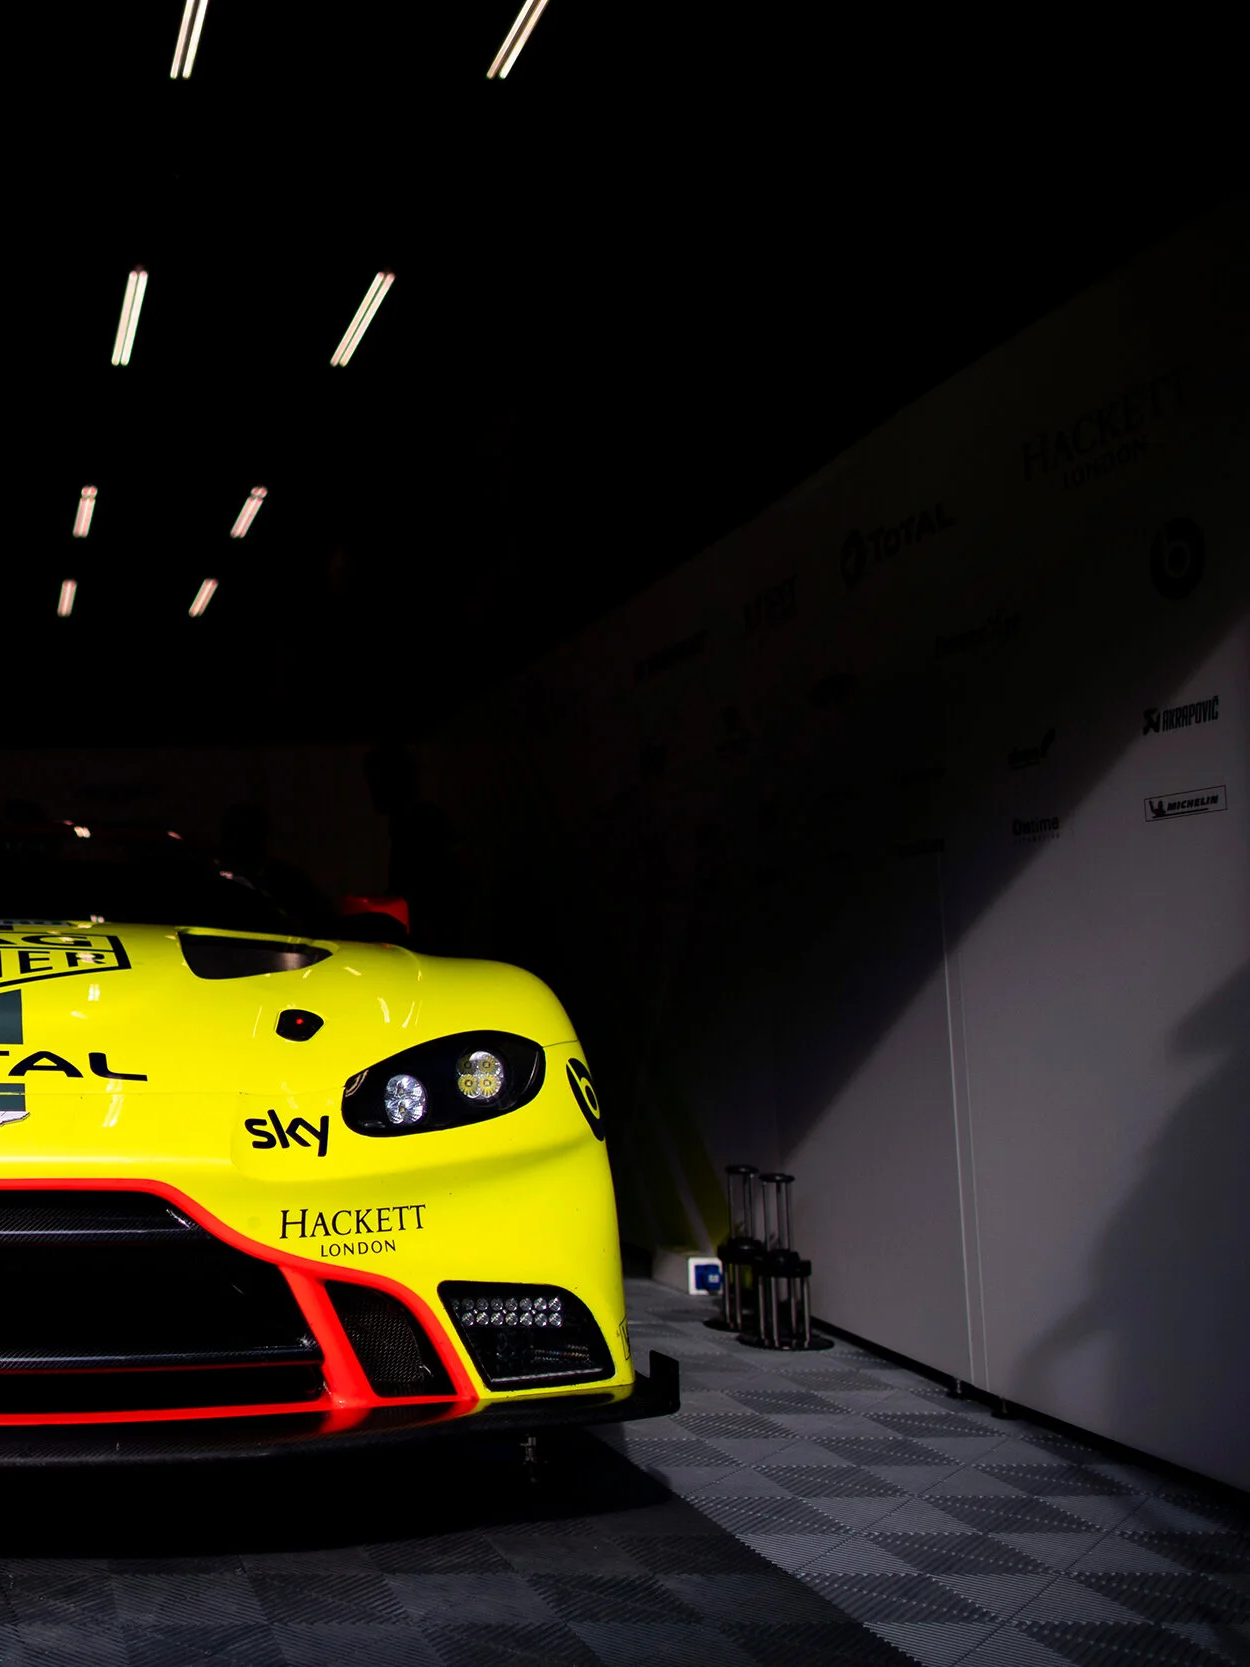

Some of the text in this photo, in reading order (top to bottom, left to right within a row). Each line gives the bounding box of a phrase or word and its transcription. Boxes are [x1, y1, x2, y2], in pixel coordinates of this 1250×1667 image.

[1022, 362, 1194, 482] HACKETT
[866, 503, 956, 563] TOTAL
[1166, 795, 1219, 811] MICHELIN
[244, 1108, 330, 1158] sky
[279, 1204, 427, 1240] HACKETT
[320, 1239, 397, 1258] LONDON
